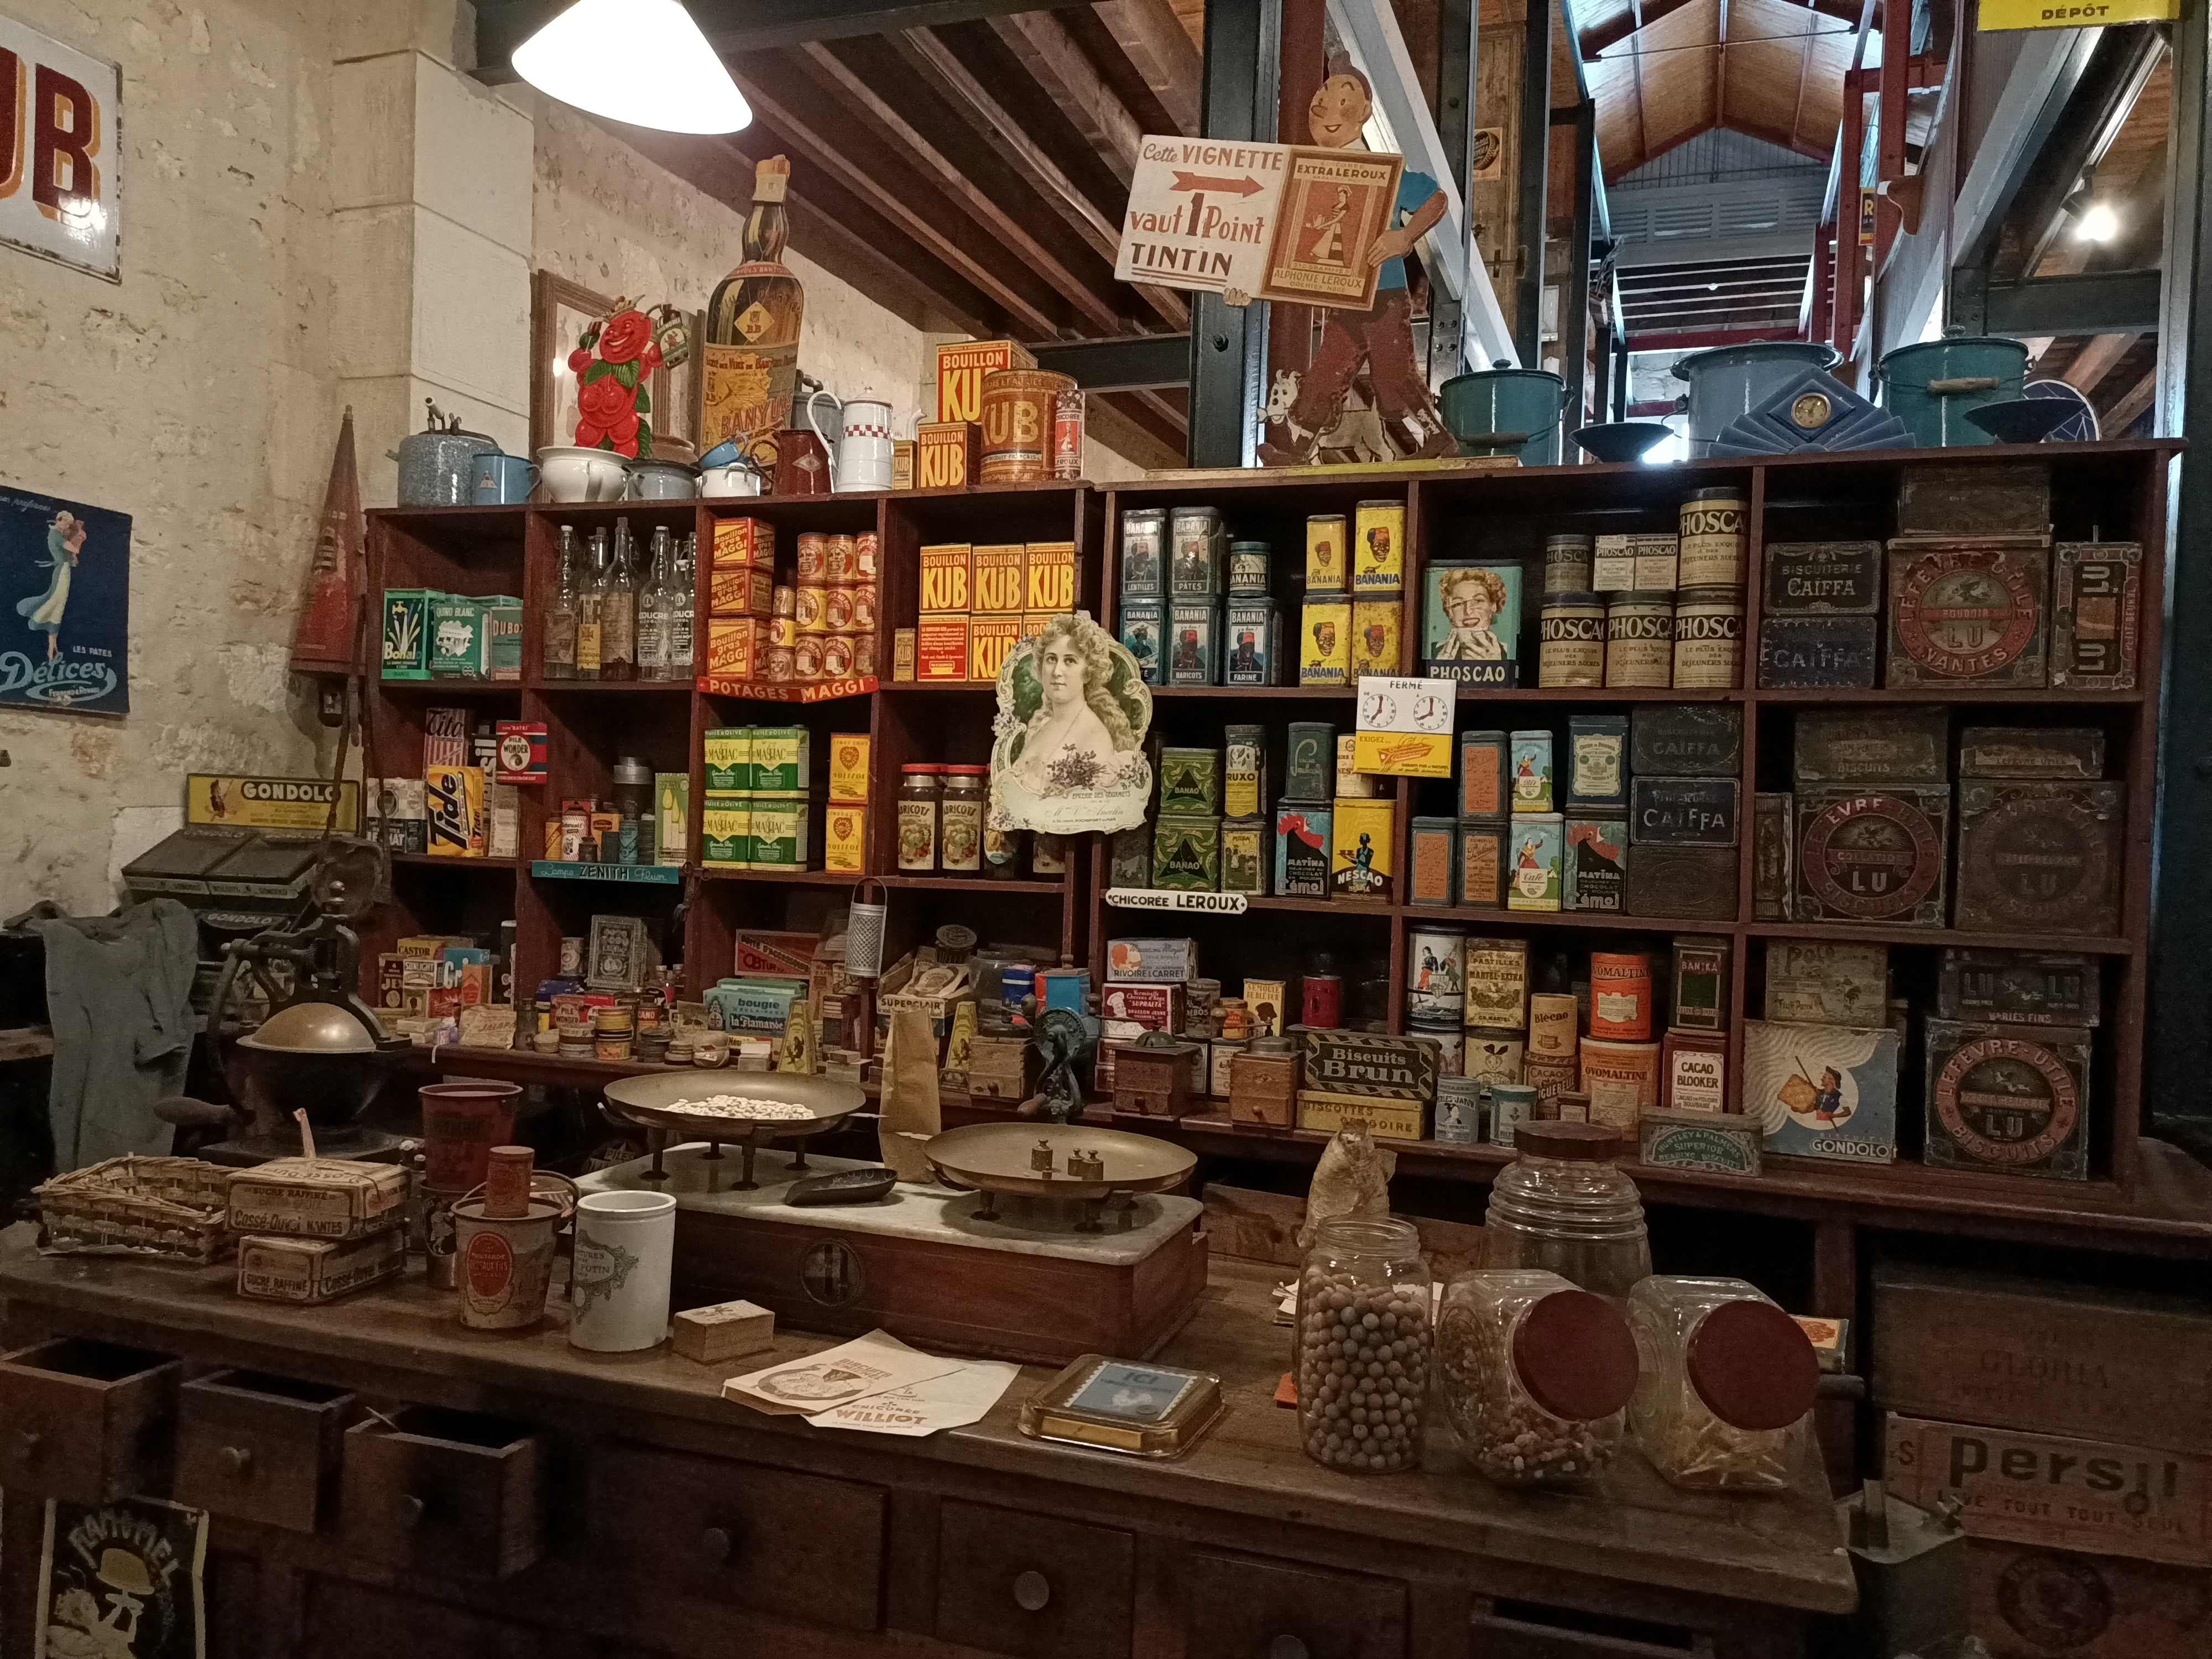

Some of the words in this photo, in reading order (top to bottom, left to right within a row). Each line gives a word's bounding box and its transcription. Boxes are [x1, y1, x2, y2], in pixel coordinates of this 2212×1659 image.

[2042, 4, 2110, 20] DÉPÔT
[1144, 143, 1178, 163] Cette
[1183, 144, 1283, 170] VIGNETTE
[1297, 164, 1333, 176] EXTRA
[1336, 168, 1386, 180] LEROUX
[1130, 205, 1183, 236] vaut
[1186, 193, 1205, 237] 1
[1203, 206, 1264, 244] Point
[1131, 243, 1232, 276] TINTIN
[1274, 270, 1318, 283] ALPHONSE
[1322, 276, 1361, 288] LEROUX
[943, 351, 1003, 369] BOUILLON
[921, 431, 963, 445] BOUILLON
[895, 456, 909, 472] KUB
[921, 444, 964, 487] KUB
[1176, 520, 1207, 533] BANANIA
[714, 528, 747, 545] Bouillon
[720, 535, 740, 549] gras
[714, 540, 747, 559] MAGGI
[1597, 547, 1634, 556] PHOSCAO
[1638, 545, 1676, 555] PHOSCAO
[924, 554, 966, 566] BOUILLON
[977, 554, 1020, 566] BOUILLON
[1029, 552, 1074, 564] BOUILLON
[712, 577, 744, 593] Bouillon
[1029, 565, 1073, 607] KUB
[1307, 575, 1341, 585] BANANIA
[1355, 573, 1400, 585] BANANIA
[2082, 566, 2110, 593] LU
[718, 585, 738, 598] gras
[923, 567, 967, 608] KUB
[976, 567, 1021, 609] KUB
[1128, 582, 1154, 591] LENTILLES
[711, 589, 744, 608] MAGGI
[455, 608, 474, 617] BLANC
[1127, 611, 1158, 620] BANANIA
[1175, 609, 1207, 621] BANANIA
[1232, 611, 1264, 623] BANANIA
[974, 625, 1018, 635] BOUILLON
[710, 630, 748, 648] Bouillon
[1947, 627, 1984, 648] LU
[718, 639, 740, 654] gras
[897, 646, 911, 661] KUB
[709, 648, 747, 669] MAGGI
[1927, 647, 2008, 672] NANTES
[2078, 643, 2106, 670] LU
[1176, 671, 1203, 680] HARICOTS
[1301, 667, 1345, 679] BANANIA
[1430, 665, 1505, 682] PHOSCAO
[709, 680, 789, 700] POTAGES
[802, 679, 864, 701] MAGGI
[1390, 680, 1423, 690] FERMÉ
[426, 710, 464, 737] Tito
[503, 744, 528, 754] WONDER
[1170, 860, 1200, 870] BANAO
[1287, 857, 1325, 867] MATINA
[580, 866, 629, 880] ZENITH
[1338, 870, 1383, 886] NESCAO
[1524, 871, 1543, 881] Café
[1578, 870, 1621, 879] MATINA
[1853, 870, 1887, 891] LU
[1112, 895, 1170, 907] CHICORÉE
[1177, 895, 1240, 911] LEROUX
[399, 946, 430, 956] CASTOR
[405, 961, 435, 971] SUNLIGHT
[1681, 961, 1718, 972] BANIKA
[1469, 971, 1523, 982] MARTEL-EXTRA
[1248, 984, 1280, 993] SEMOULE
[738, 998, 780, 1010] bougie
[2028, 1013, 2051, 1024] FINS
[1331, 1047, 1406, 1065] Biscuits
[1322, 1059, 1416, 1085] Brun
[1530, 1067, 1563, 1078] CACAO
[1585, 1067, 1647, 1080] OVOMALTINE
[1681, 1061, 1714, 1075] CACAO
[1677, 1076, 1718, 1089] BLOOKER
[1303, 1100, 1374, 1117] BISCOTTES
[1986, 1114, 2023, 1138] LU
[306, 1220, 342, 1234] NANTES
[836, 1410, 927, 1425] WILLIOT
